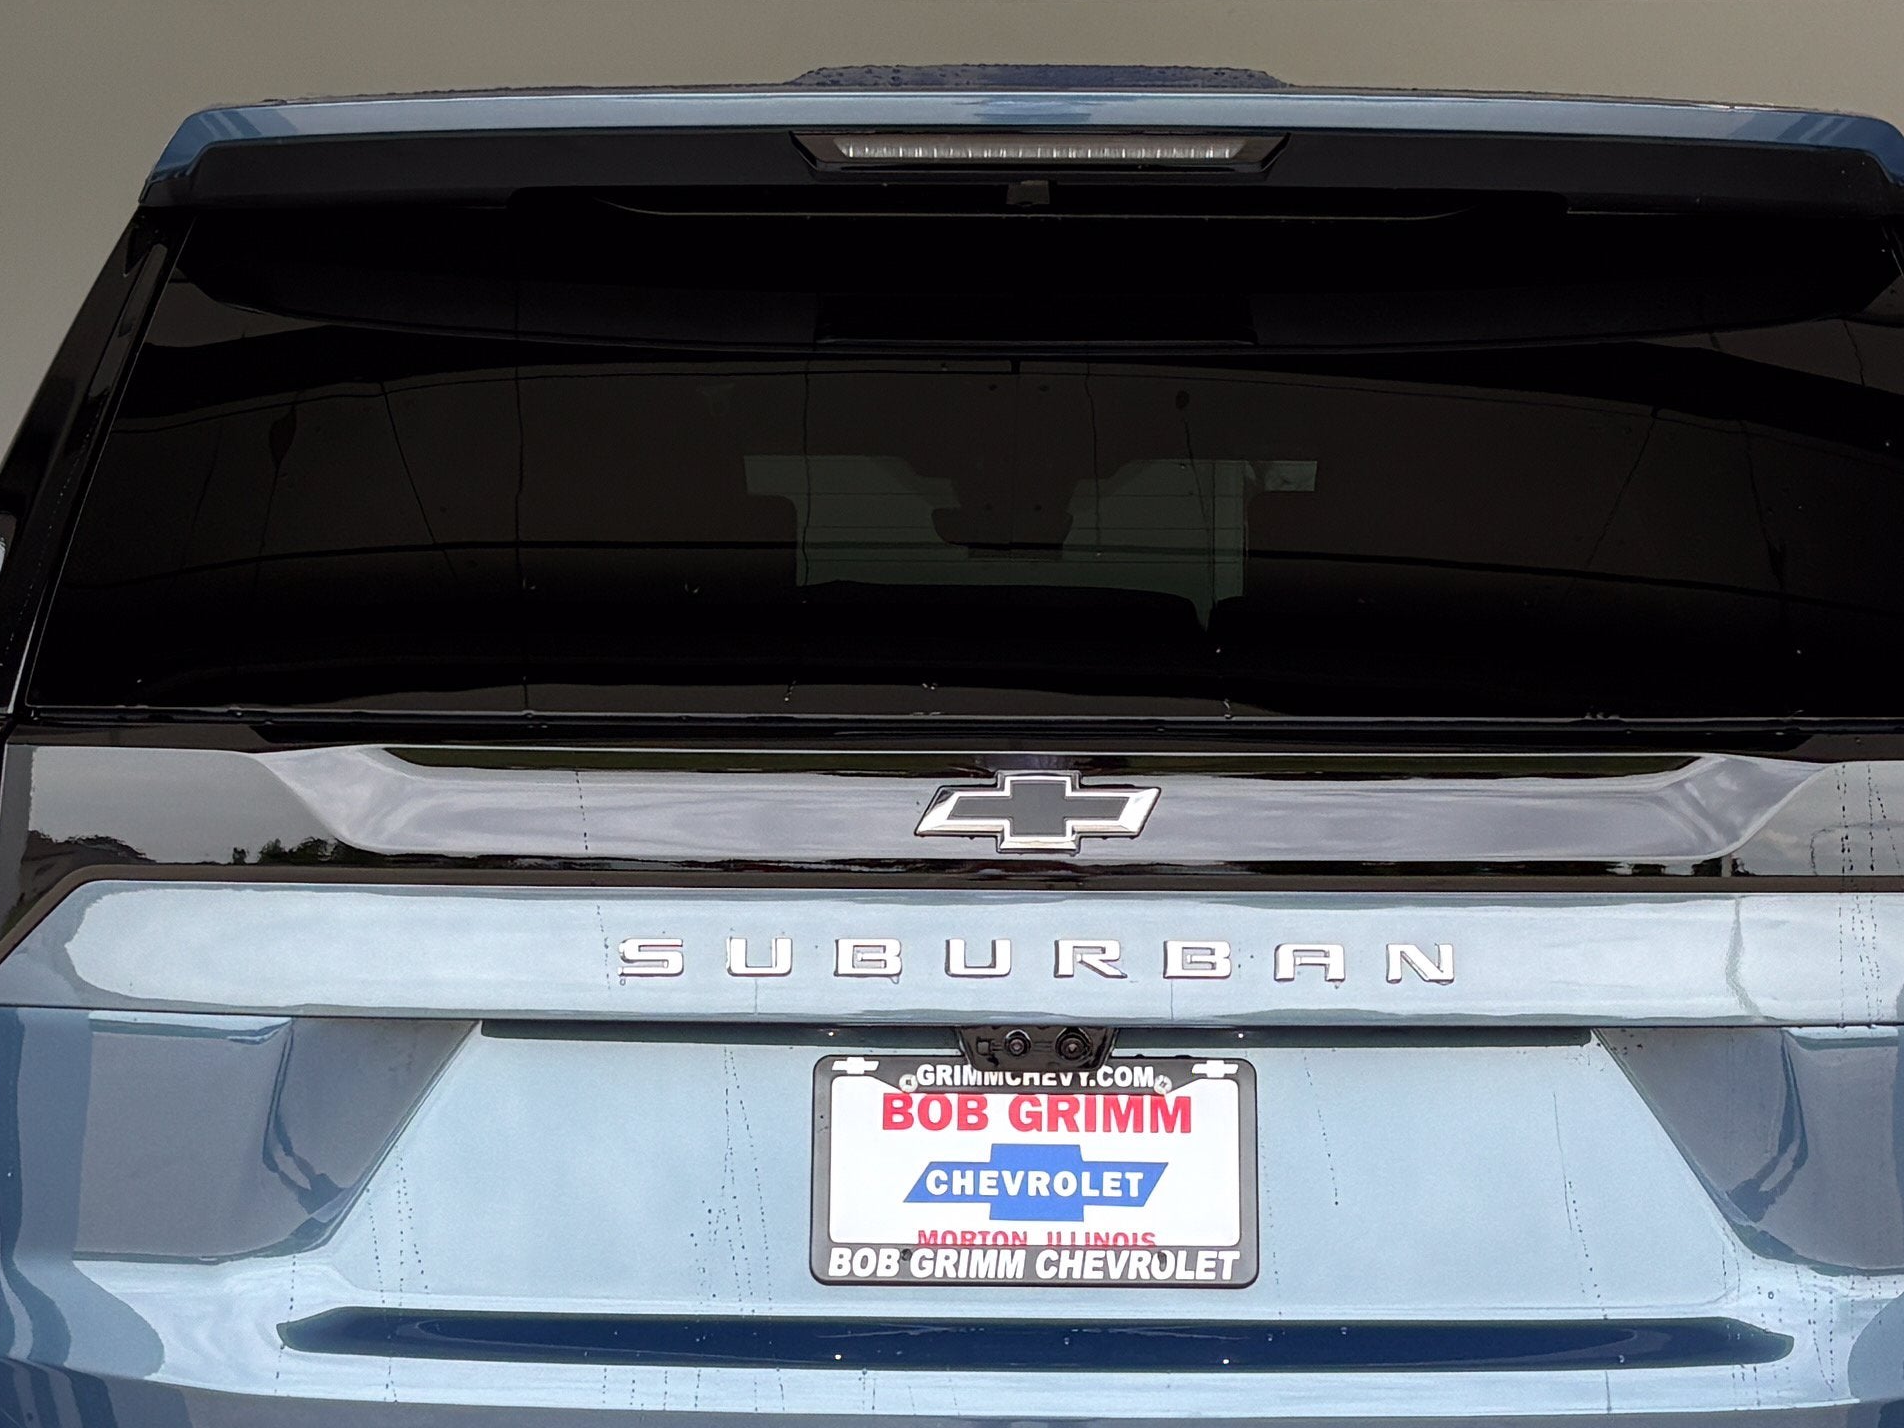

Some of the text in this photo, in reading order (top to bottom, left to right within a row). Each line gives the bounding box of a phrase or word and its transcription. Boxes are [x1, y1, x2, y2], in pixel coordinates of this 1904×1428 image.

[618, 937, 1455, 984] SUBURBAN
[882, 1093, 1192, 1134] BOB GRIMM
[925, 1169, 1144, 1198] CHEVROLET
[828, 1247, 1240, 1281] BOB GRIMM CHEVROLET
